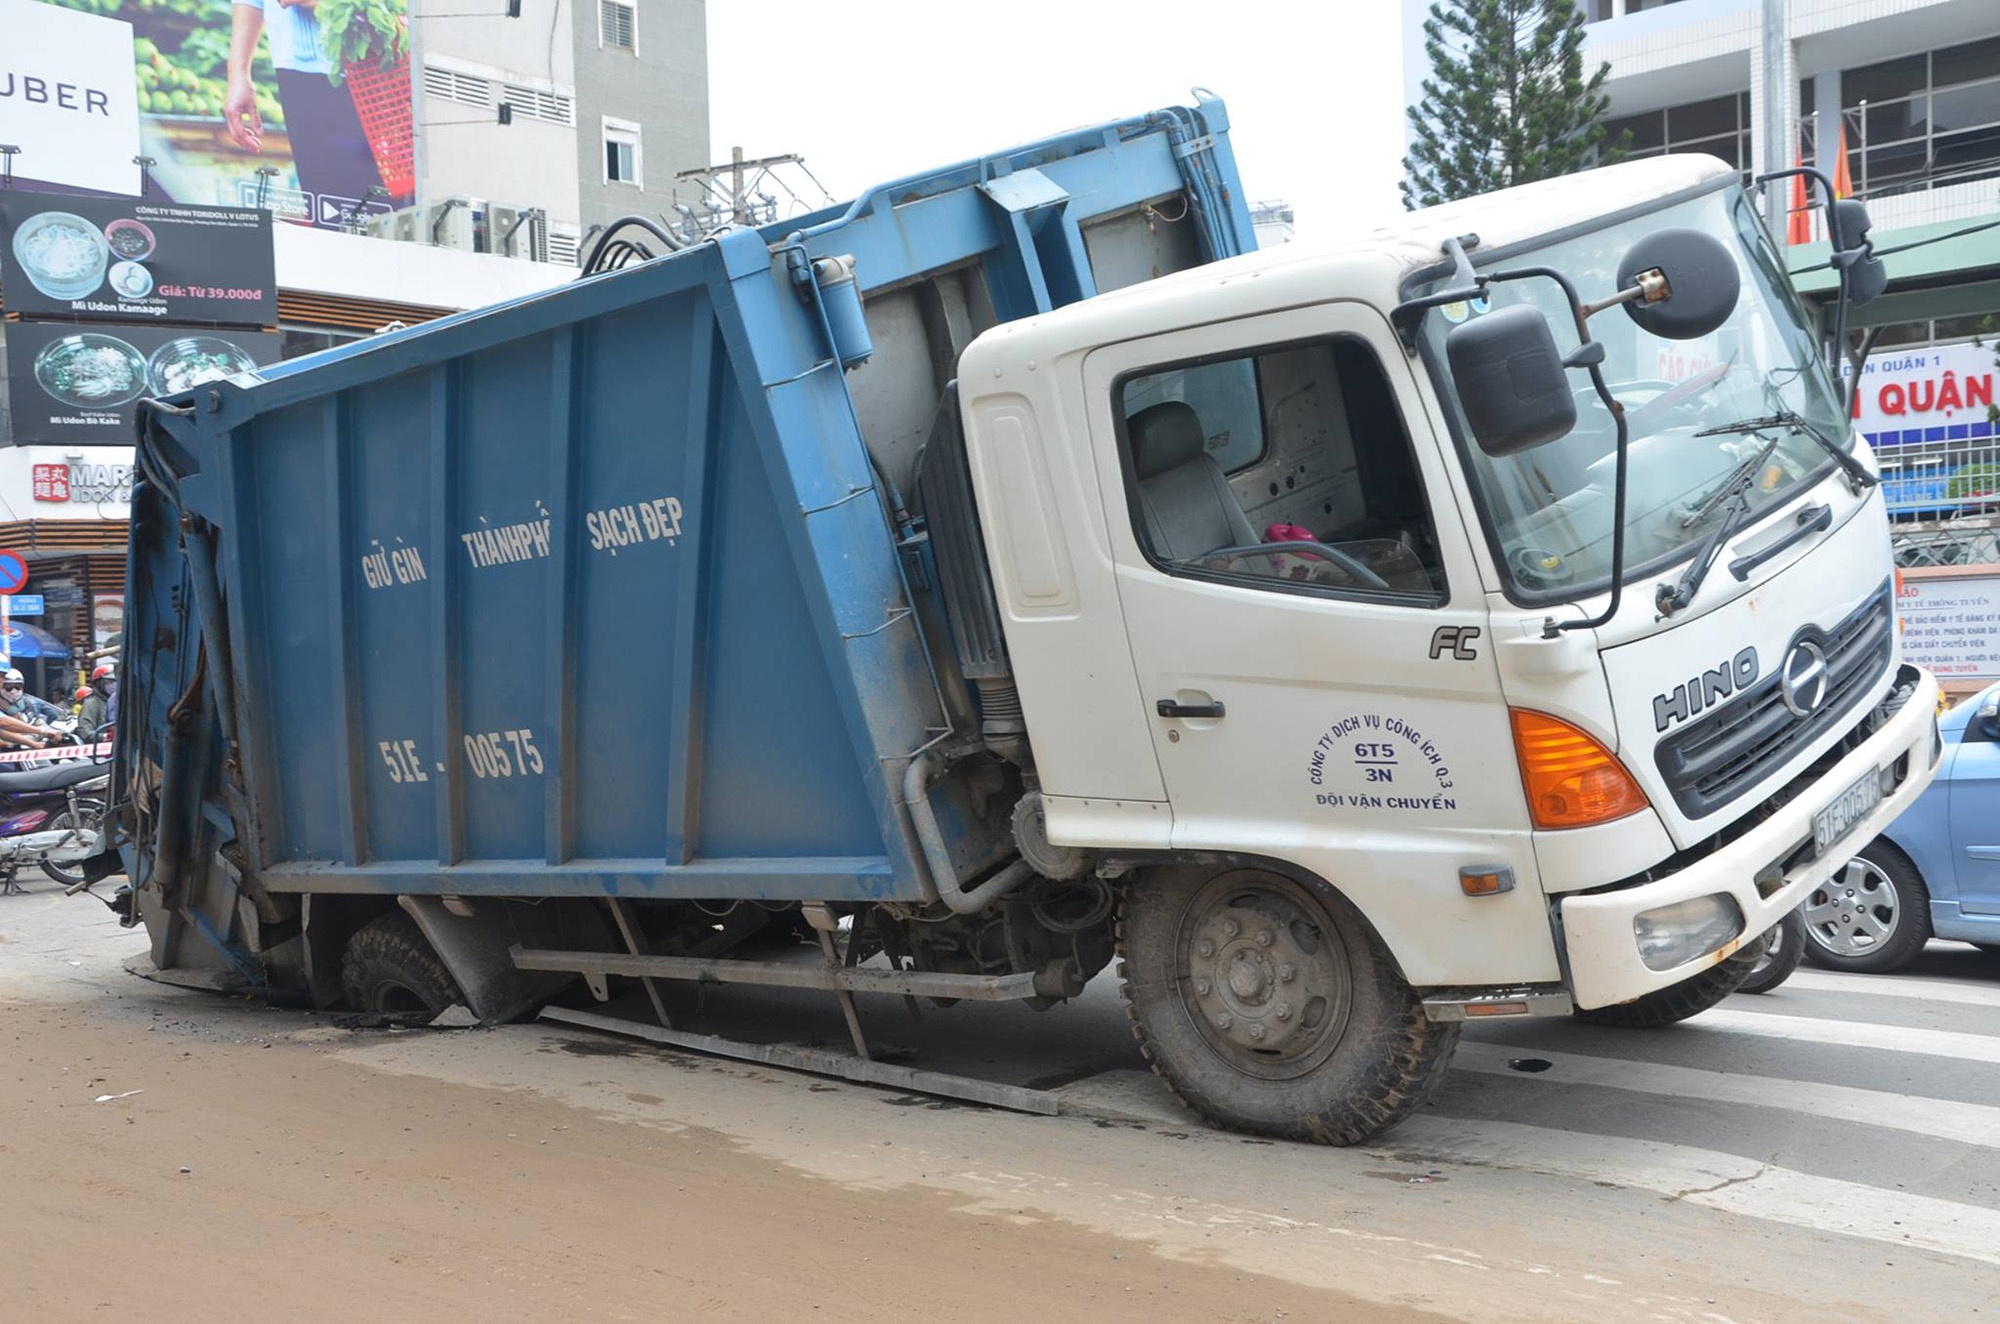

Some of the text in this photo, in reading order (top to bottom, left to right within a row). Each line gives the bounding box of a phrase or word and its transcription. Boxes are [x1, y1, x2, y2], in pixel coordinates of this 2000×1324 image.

[158, 285, 263, 300] Giá: Từ 39.000đ
[71, 301, 168, 316] Mì Udon Kamaage
[1882, 356, 1925, 372] QUẬN
[1933, 356, 1941, 366] 1
[1878, 370, 1992, 417] QUẬN
[62, 416, 85, 424] Udon
[70, 464, 134, 487] MAR
[392, 536, 428, 585] GÌN
[586, 505, 643, 556] SẠCH
[638, 497, 683, 547] ĐẸP
[1429, 626, 1480, 660] FC
[1653, 646, 1760, 733] HINO
[1307, 715, 1453, 789] CÔNG TY DỊCH VỤ CÔNG ÍCH Q.3
[1355, 743, 1395, 758] 6T5
[379, 740, 429, 783] 51E
[1365, 768, 1393, 782] 3N
[1316, 792, 1456, 810] ĐỘI VẬN CHUYỂN
